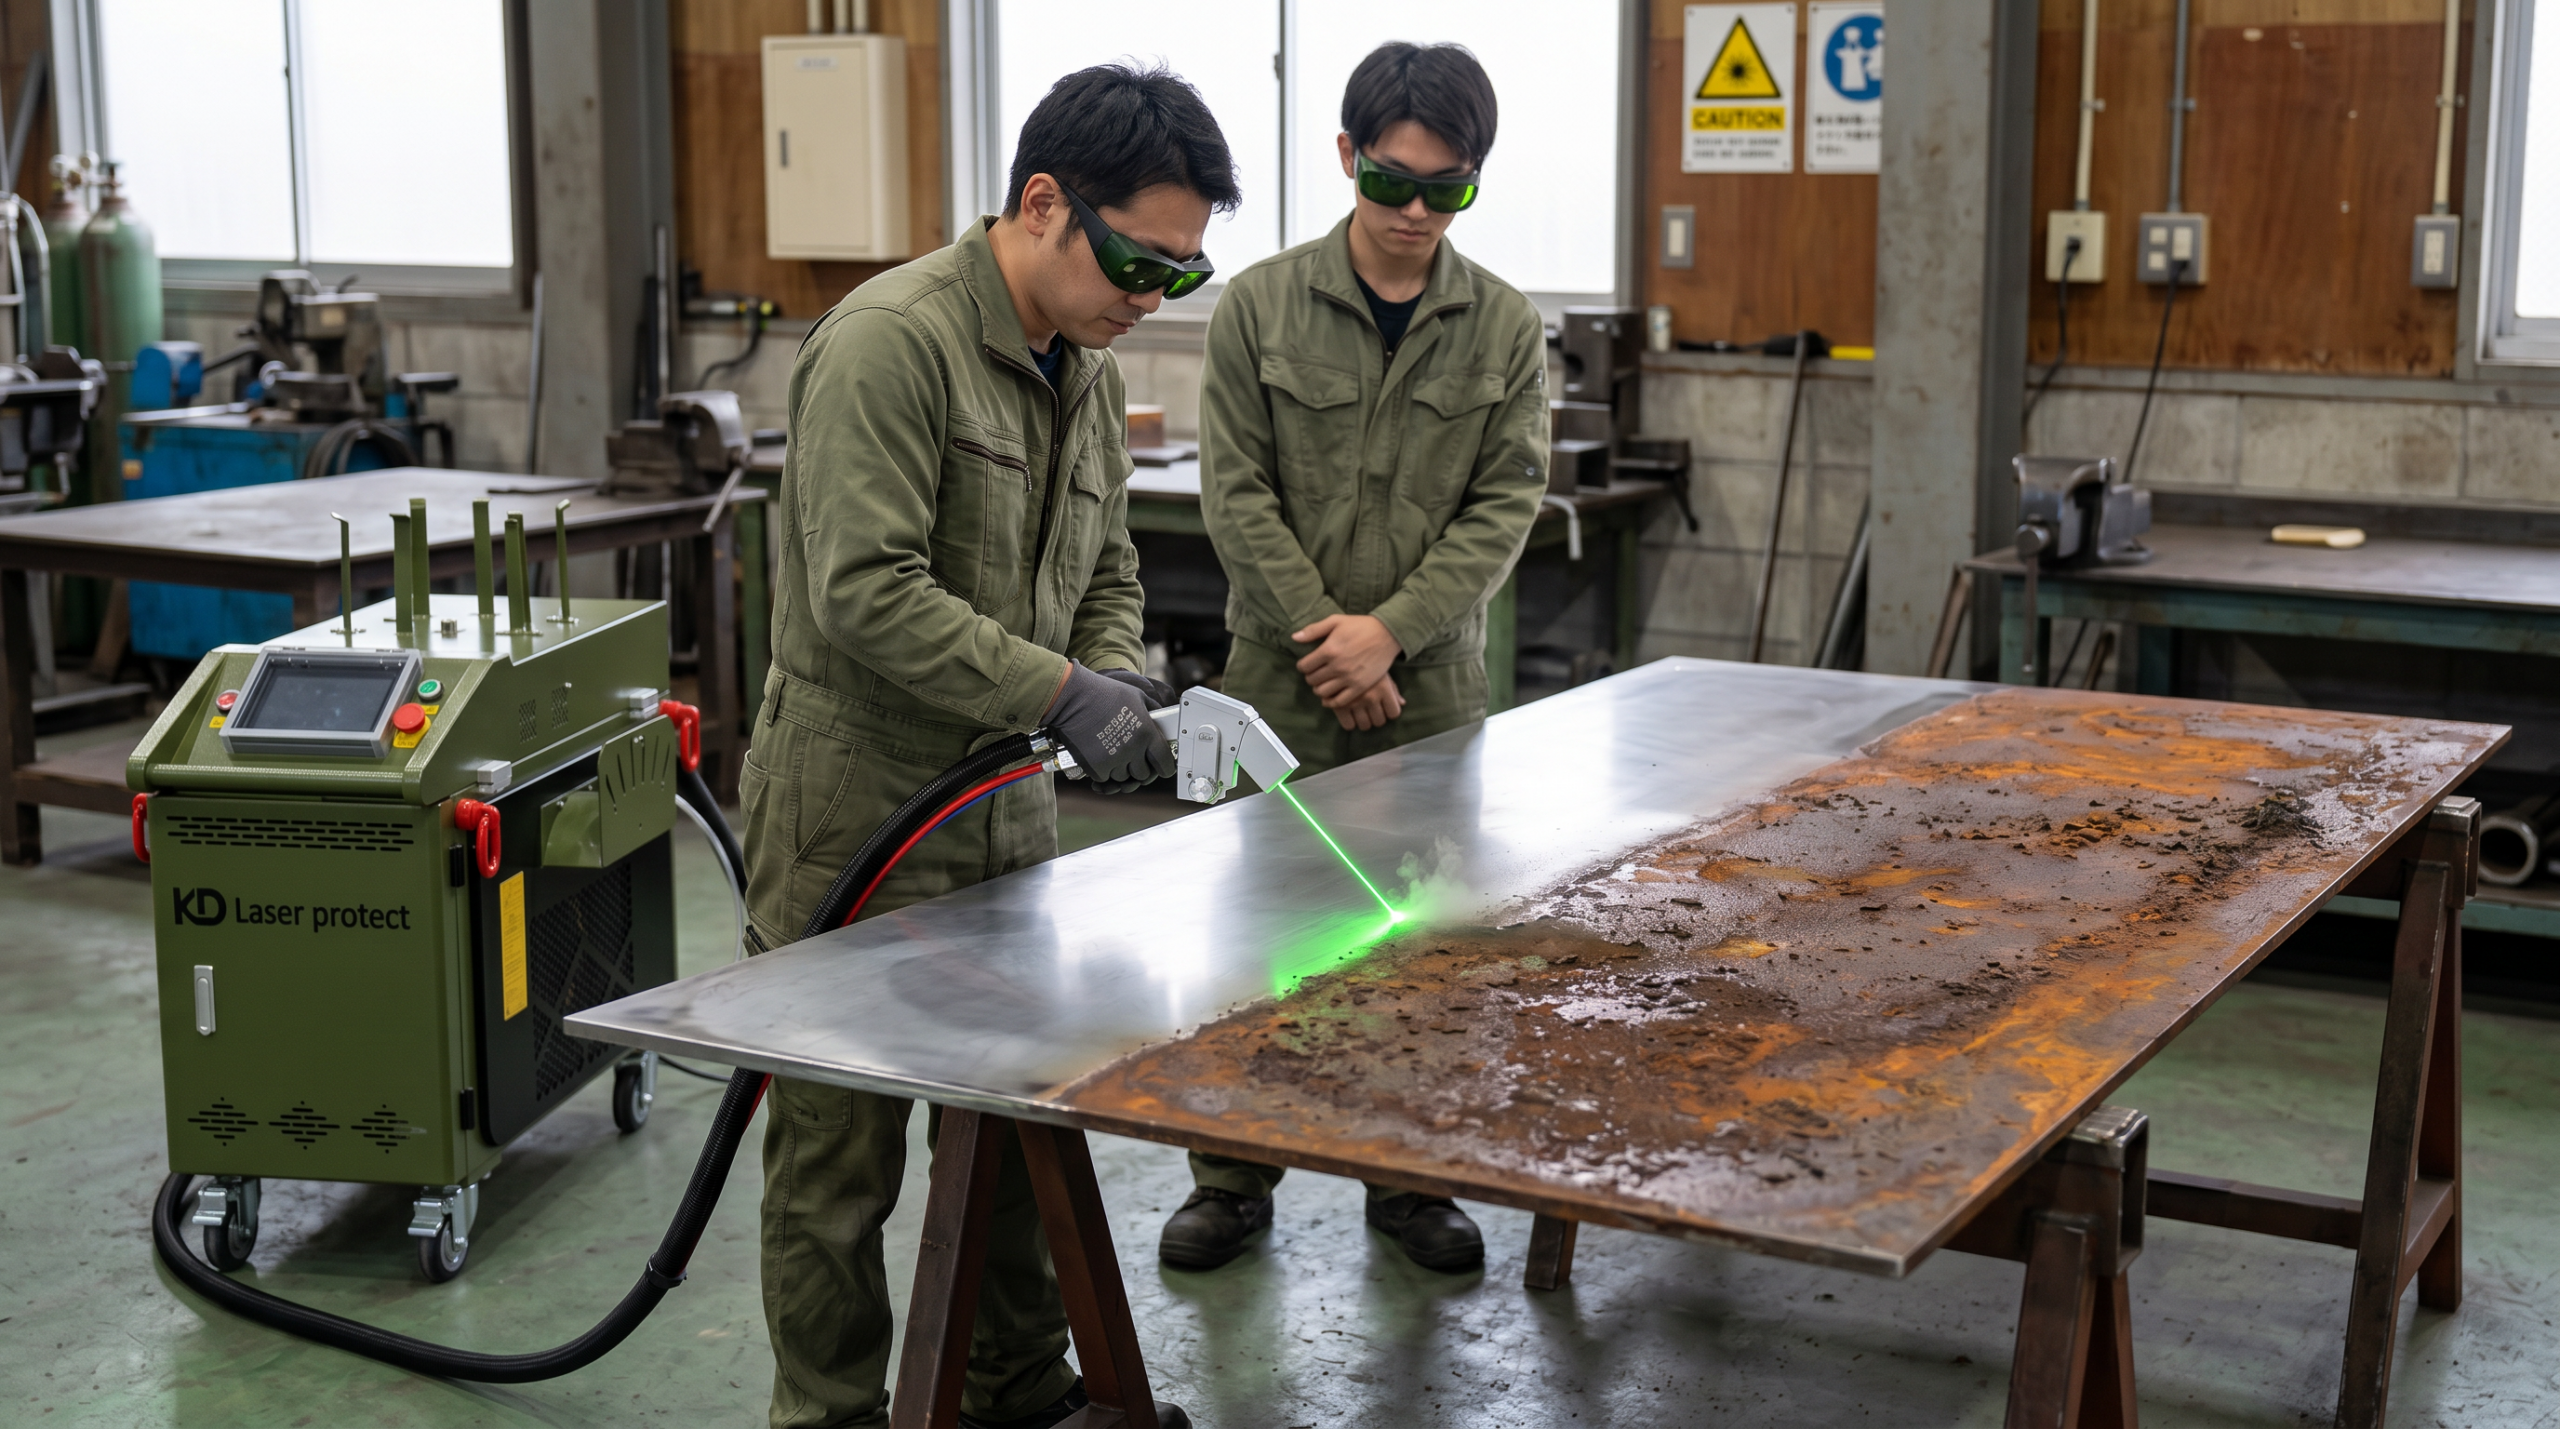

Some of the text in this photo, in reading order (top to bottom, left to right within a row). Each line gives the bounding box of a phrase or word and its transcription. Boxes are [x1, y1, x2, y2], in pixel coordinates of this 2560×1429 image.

[1693, 110, 1782, 128] CAUTION
[172, 886, 412, 933] KD Laser protect
